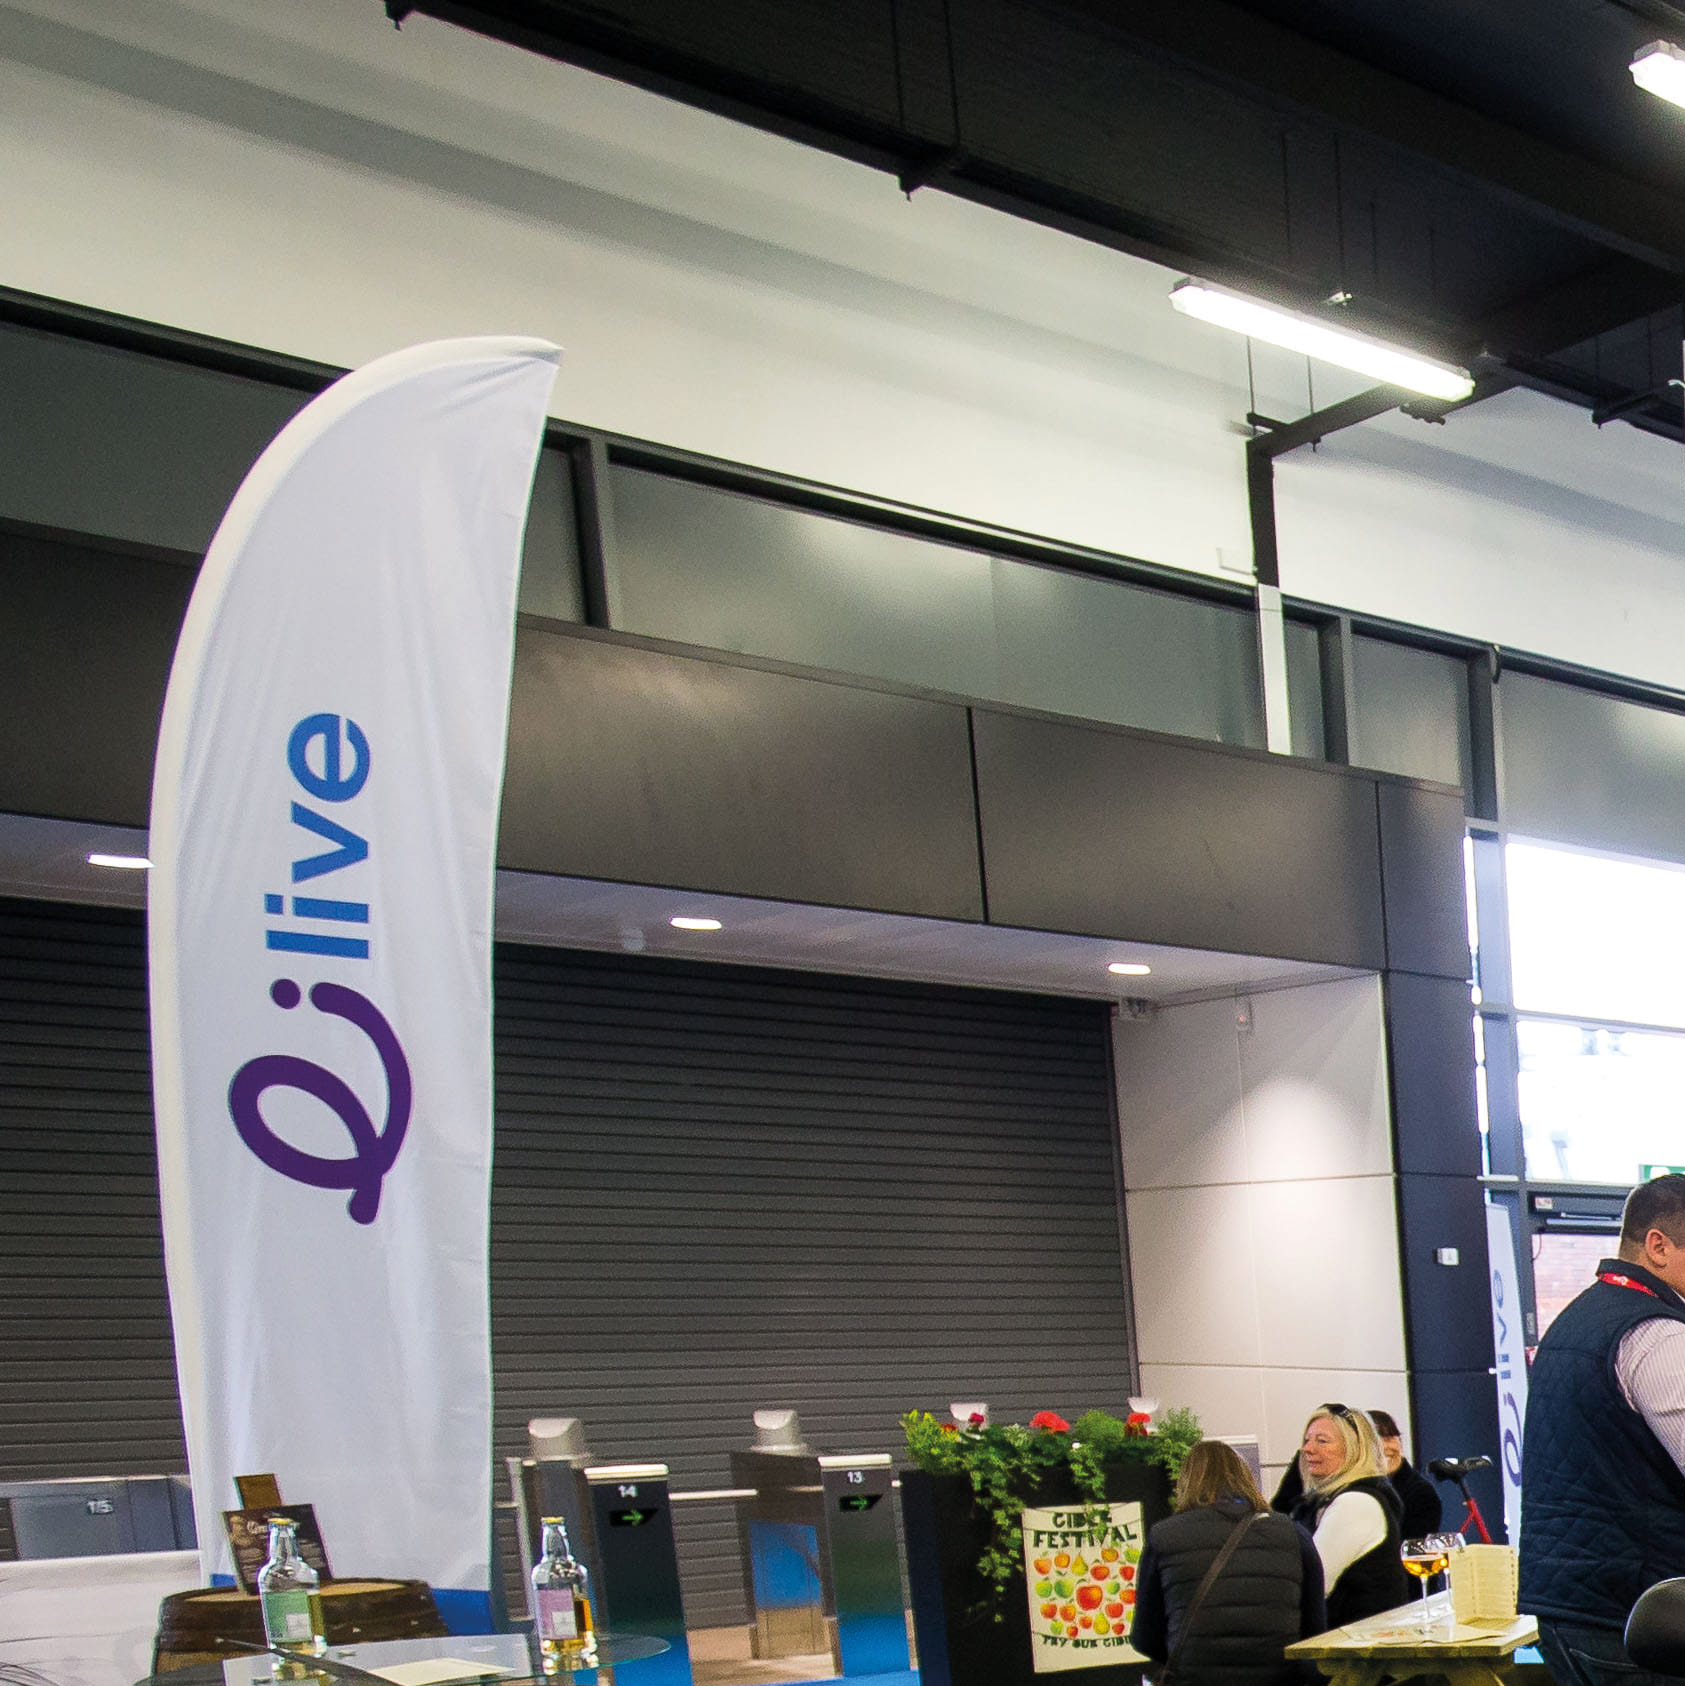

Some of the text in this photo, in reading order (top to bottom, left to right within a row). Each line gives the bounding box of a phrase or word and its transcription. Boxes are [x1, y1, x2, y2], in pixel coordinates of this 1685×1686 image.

[265, 711, 372, 961] live
[847, 1471, 864, 1484] 13
[618, 1485, 638, 1498] 14
[87, 1499, 114, 1515] 15
[1033, 1524, 1137, 1548] FESTIVAL
[1043, 1634, 1067, 1648] TRY
[1072, 1638, 1098, 1649] OUR
